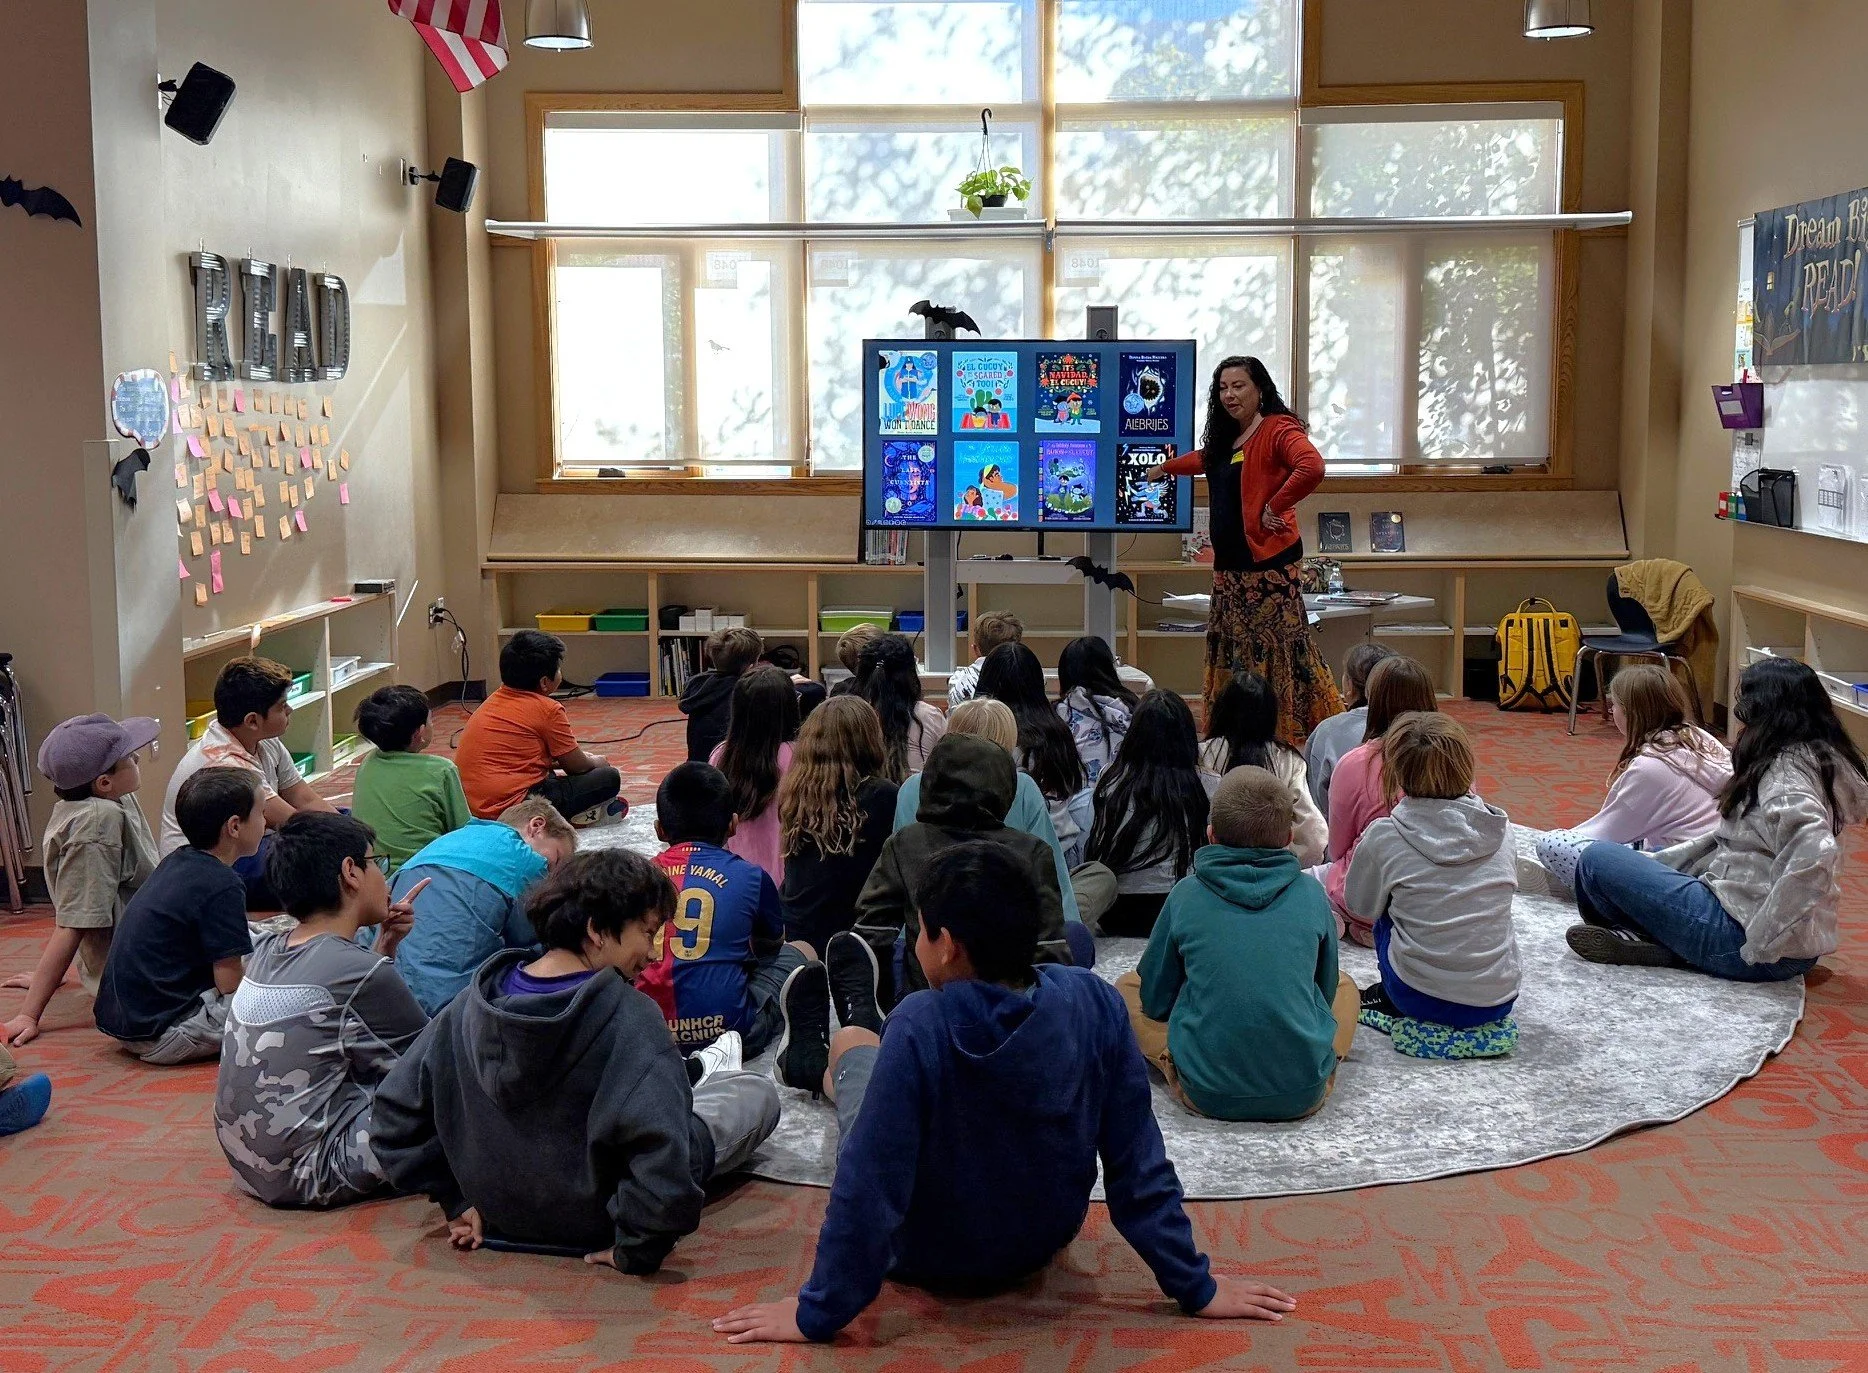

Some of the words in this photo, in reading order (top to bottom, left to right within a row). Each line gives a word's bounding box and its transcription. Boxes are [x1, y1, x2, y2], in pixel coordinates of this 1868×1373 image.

[1783, 213, 1842, 259] Dream
[1801, 249, 1862, 319] READ!
[189, 251, 351, 383] READ
[974, 371, 1003, 380] SCARED
[911, 420, 936, 430] DANCE
[1124, 418, 1169, 432] ALEBRIJES
[1127, 452, 1167, 466] XOLO
[663, 864, 687, 877] INE
[690, 864, 729, 888] YAMAL
[668, 1014, 724, 1032] UNHCR
